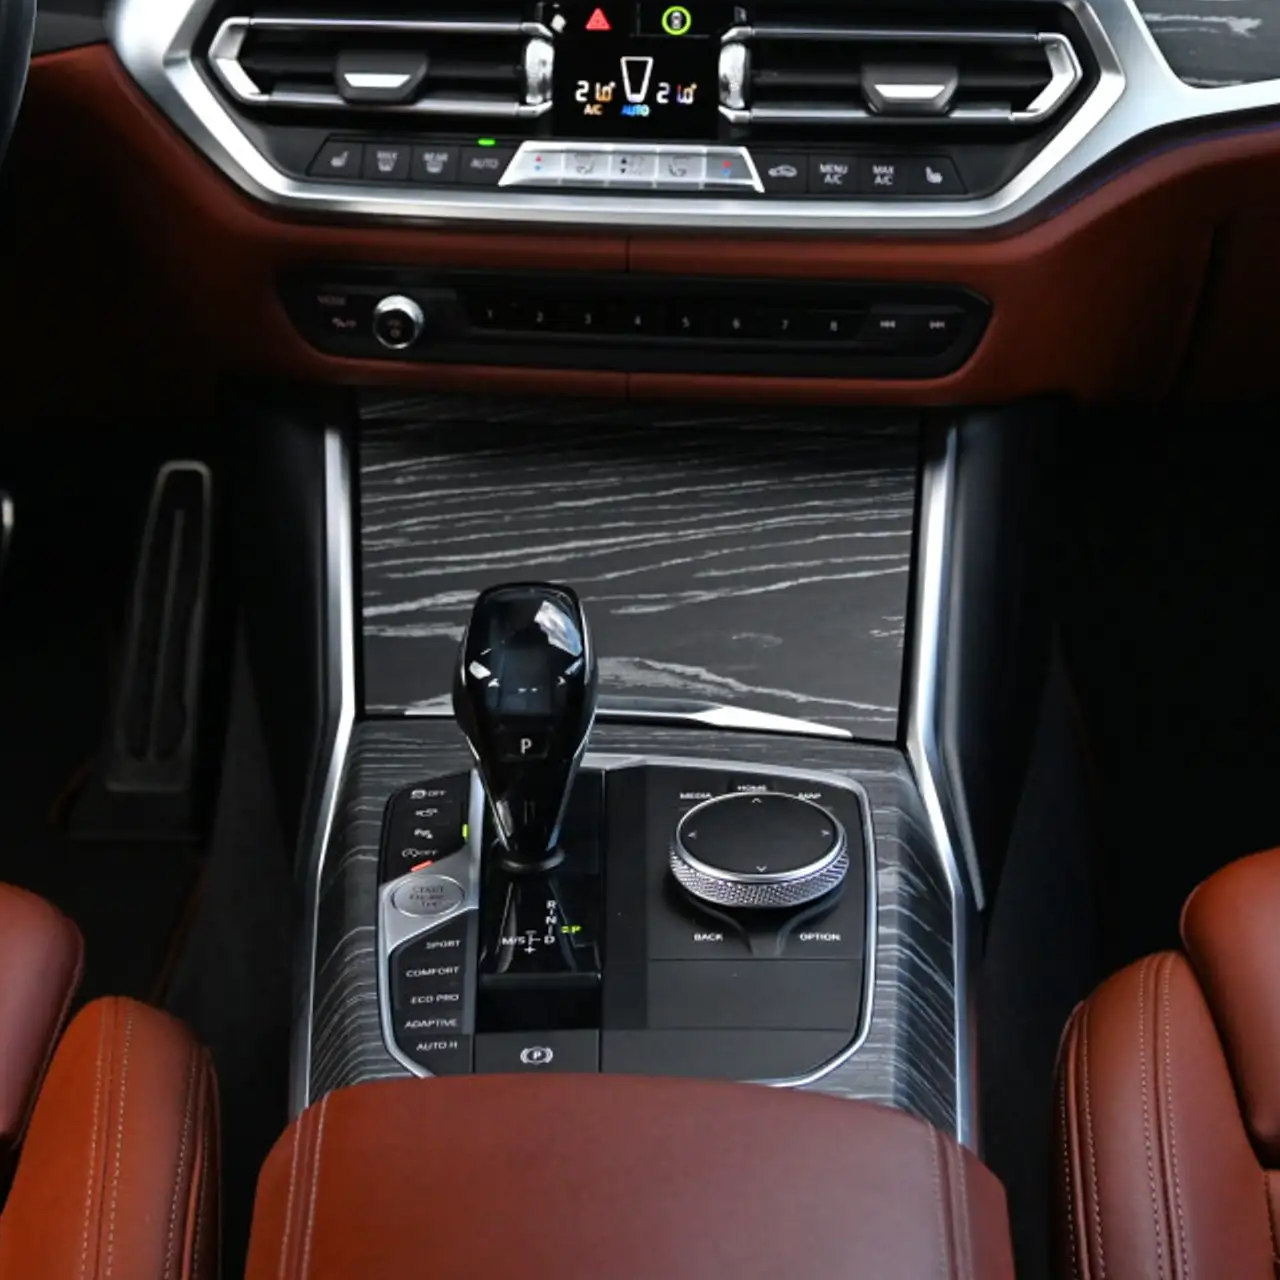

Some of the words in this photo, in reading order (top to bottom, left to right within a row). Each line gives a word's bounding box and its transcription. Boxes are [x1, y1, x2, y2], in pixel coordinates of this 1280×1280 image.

[584, 104, 603, 116] A/C
[621, 104, 651, 117] AUTO
[470, 157, 500, 169] AUTO
[820, 163, 849, 175] MENU
[872, 165, 895, 175] MAX
[824, 174, 843, 185] A/C
[874, 175, 894, 186] A/C
[520, 737, 532, 755] P
[679, 792, 712, 800] MEDIA
[546, 899, 557, 910] R
[545, 915, 557, 925] N
[543, 935, 556, 945] D
[693, 932, 724, 942] BACK
[799, 932, 842, 942] OPTION
[425, 940, 461, 950] SPORT
[405, 966, 460, 978] COMFORT
[410, 995, 434, 1005] ECO
[435, 993, 460, 1003] PRO
[404, 1018, 458, 1029] ADAPTIVE
[415, 1041, 448, 1052] AUTO
[448, 1040, 458, 1049] H
